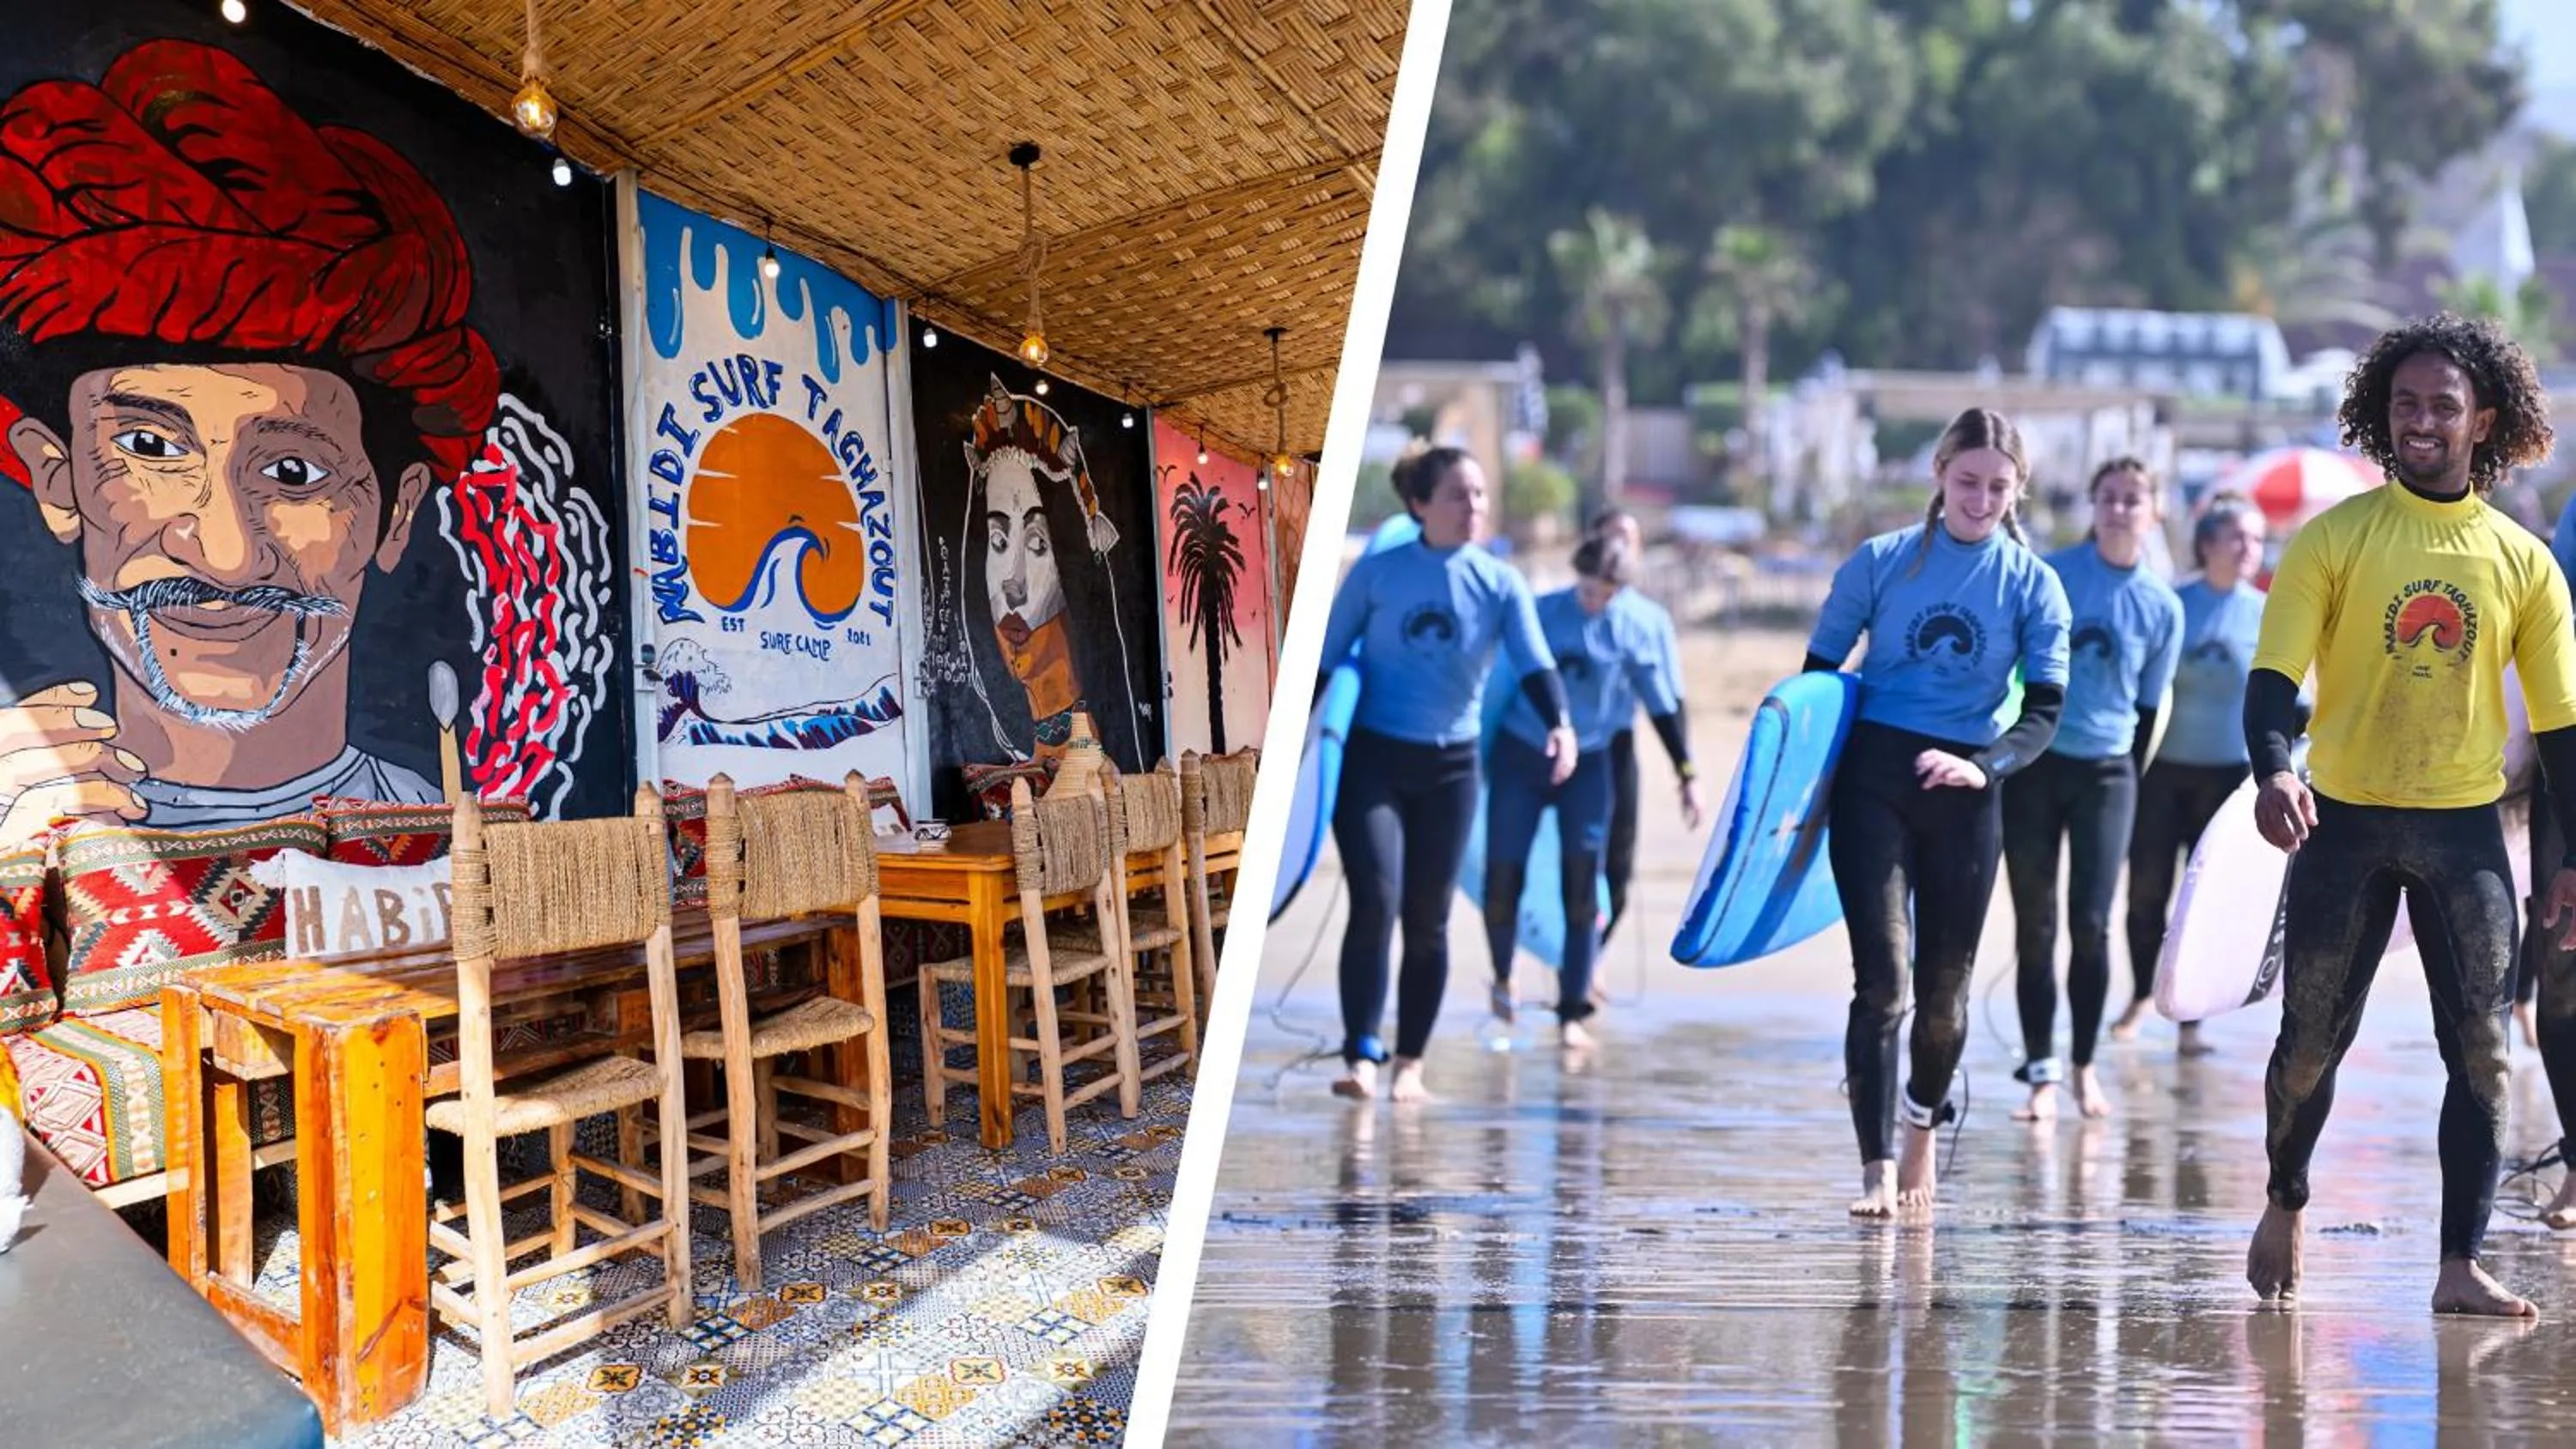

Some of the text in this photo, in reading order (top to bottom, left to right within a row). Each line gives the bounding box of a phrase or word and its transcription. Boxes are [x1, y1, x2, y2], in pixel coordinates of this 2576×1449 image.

[688, 353, 783, 422] SURF
[802, 373, 895, 627] TAGHAZOUT
[2403, 579, 2442, 599] SURF
[721, 615, 871, 646] EST 2021
[760, 631, 831, 662] SURF CAMP
